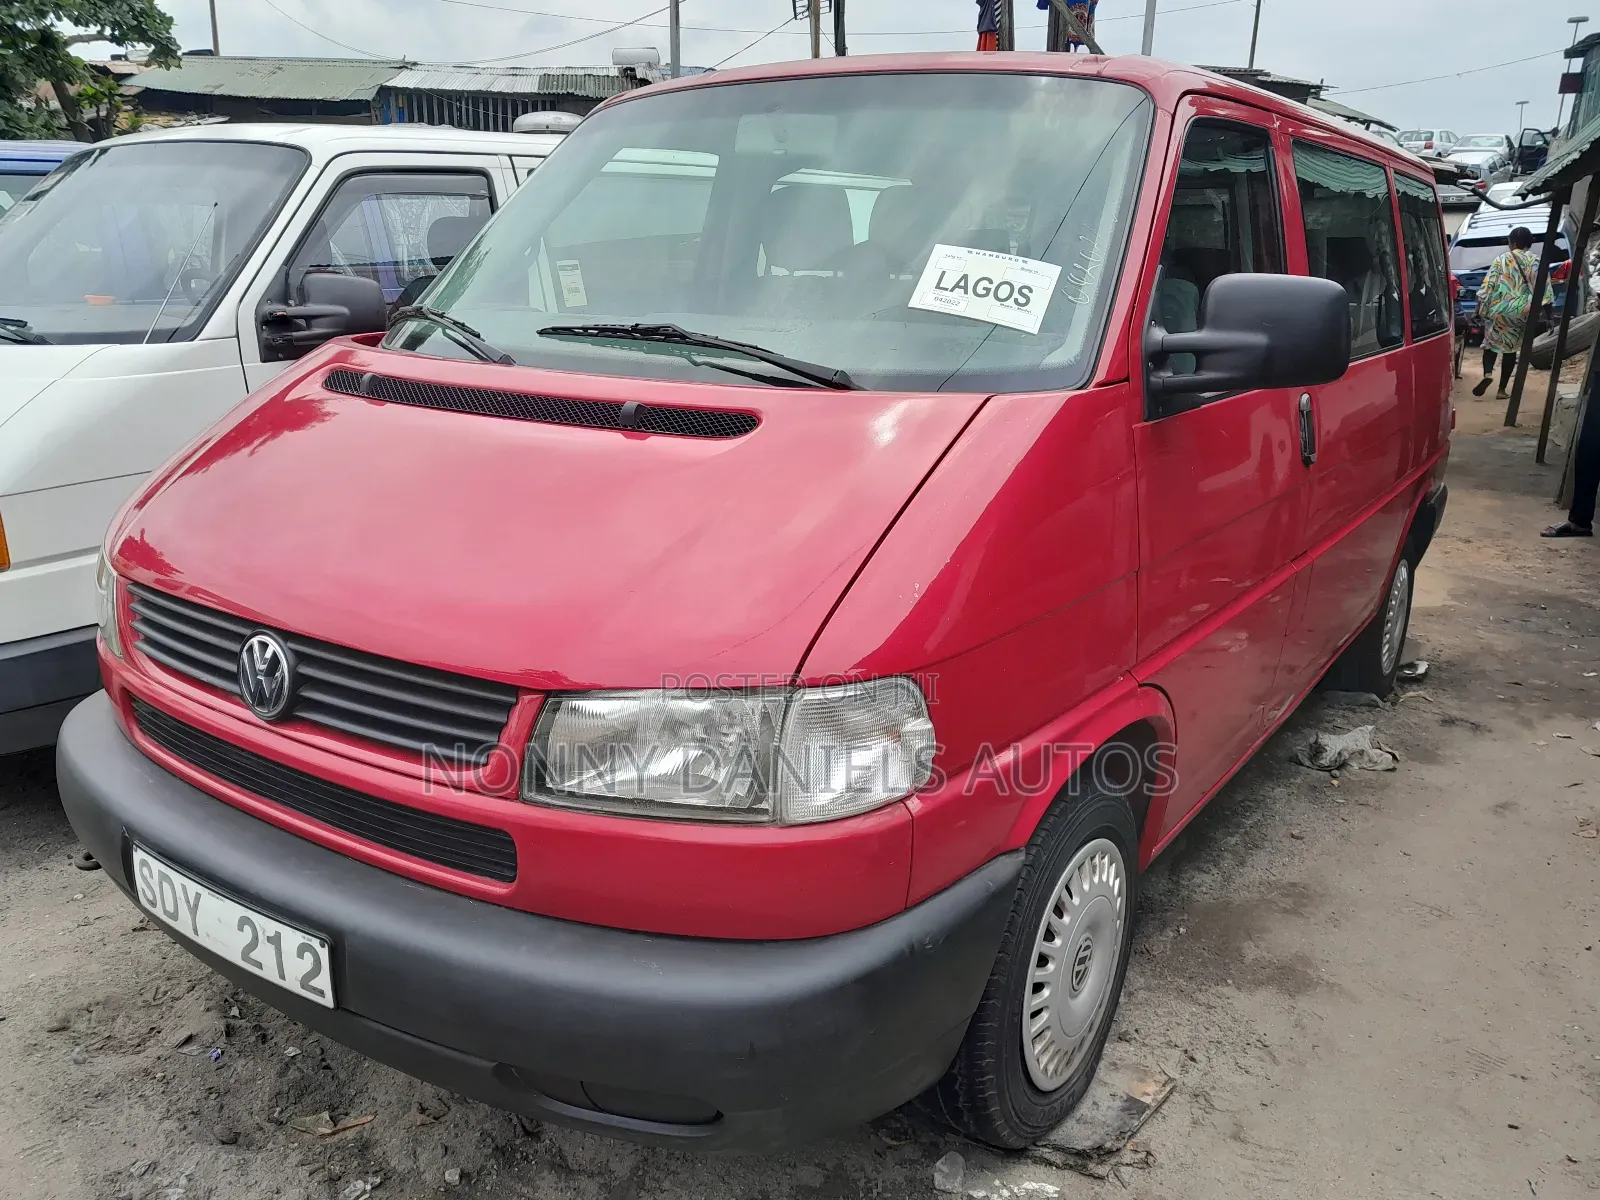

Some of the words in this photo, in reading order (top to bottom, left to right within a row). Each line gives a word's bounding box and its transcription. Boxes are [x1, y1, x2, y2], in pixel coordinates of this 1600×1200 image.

[934, 270, 1034, 308] LAGOS
[138, 857, 202, 937] SDY
[237, 915, 326, 999] 212
